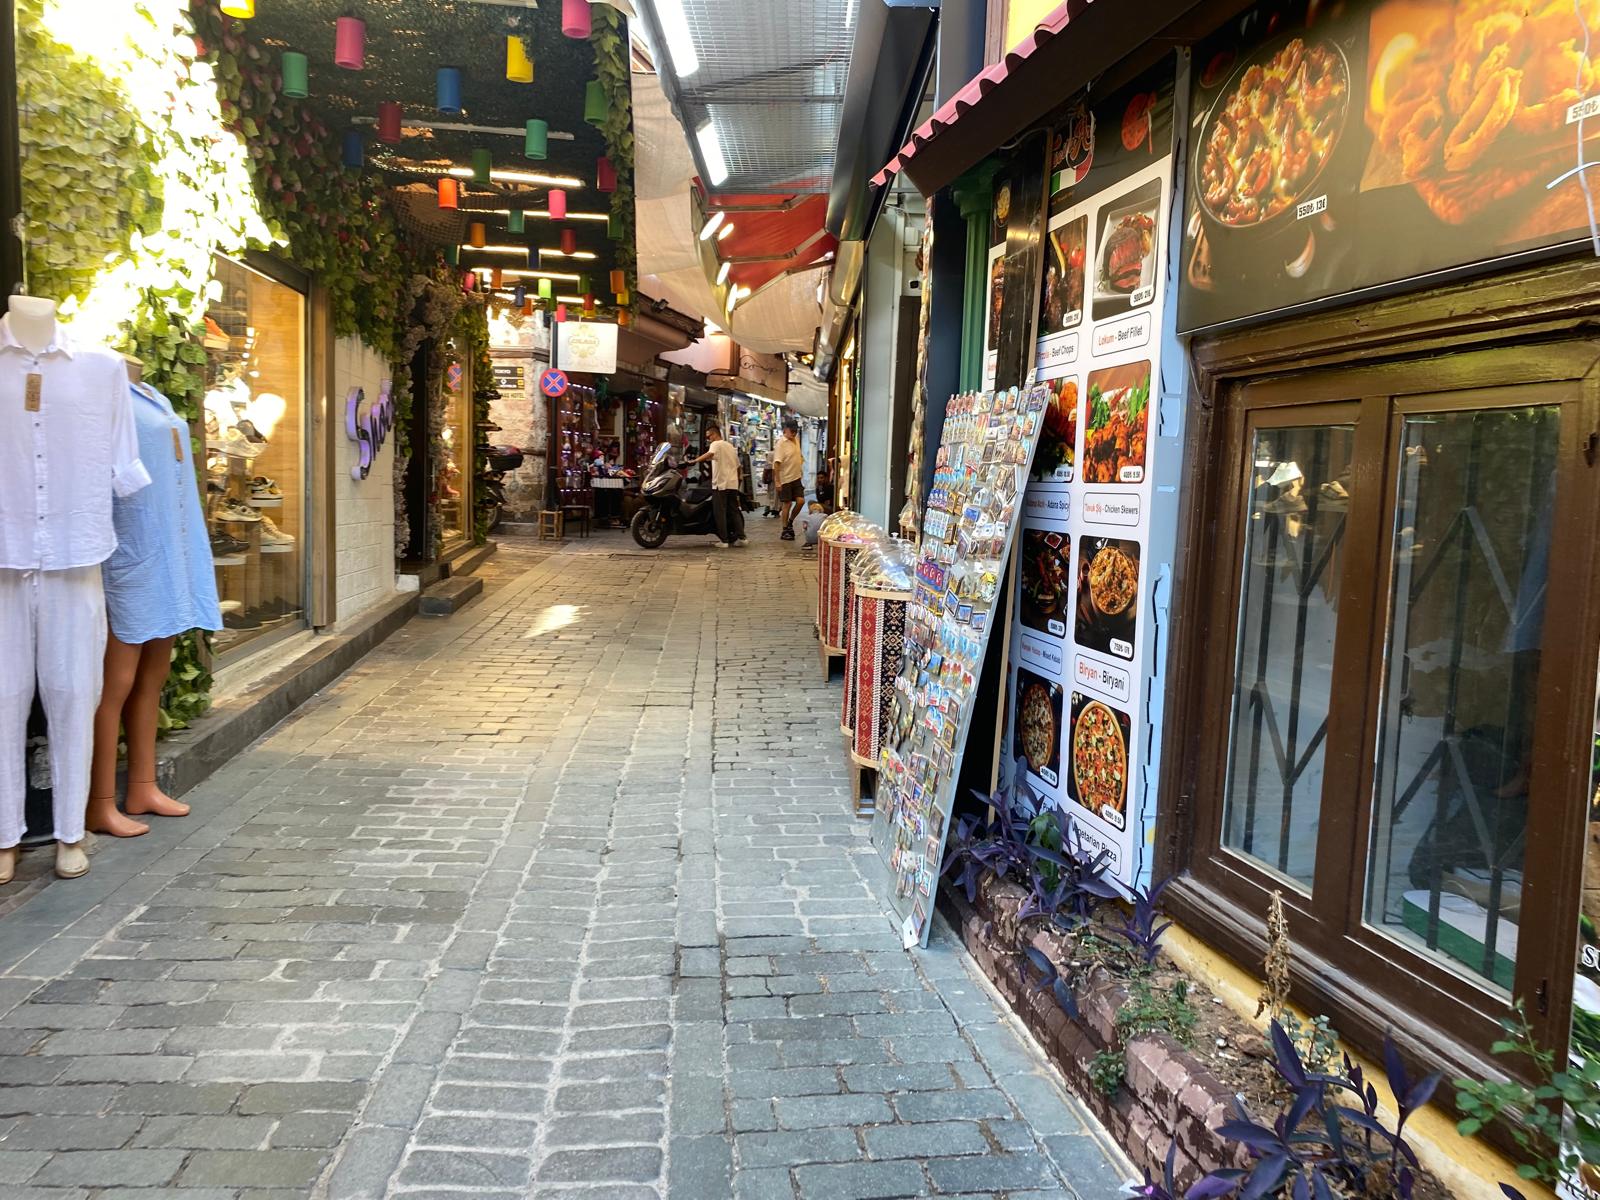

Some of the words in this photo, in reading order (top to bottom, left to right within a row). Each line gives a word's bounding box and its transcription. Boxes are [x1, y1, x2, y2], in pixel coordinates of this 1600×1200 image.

[1118, 328, 1130, 341] Beef
[1130, 325, 1143, 338] Fillet
[1104, 504, 1120, 513] Chicken
[1121, 504, 1138, 515] Skewers
[1079, 661, 1098, 680] Biryan
[1102, 670, 1125, 690] Biryani
